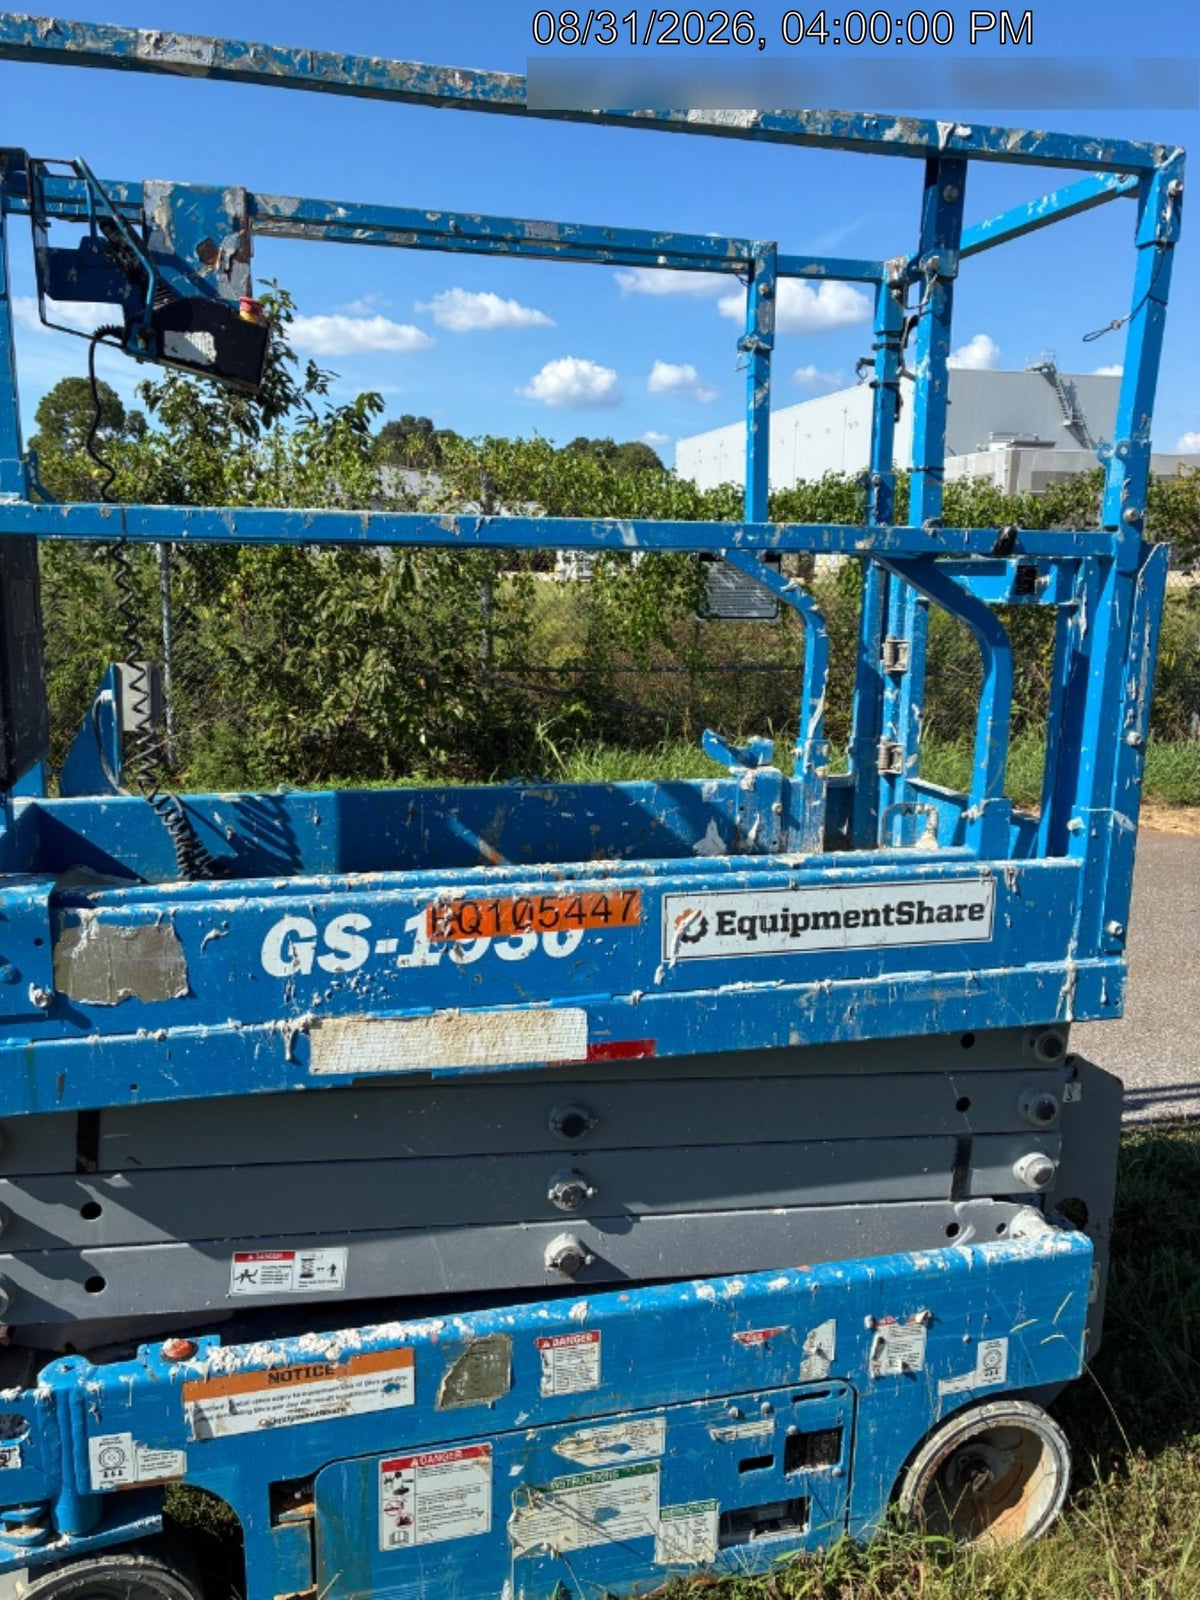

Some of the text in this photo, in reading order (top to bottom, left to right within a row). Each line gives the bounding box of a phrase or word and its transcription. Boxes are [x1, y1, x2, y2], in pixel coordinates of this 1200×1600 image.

[715, 901, 986, 941] EquipmentShare
[553, 1333, 593, 1347] DANGER
[268, 1363, 335, 1384] NOTICE
[420, 1450, 463, 1464] DANGER
[550, 1469, 619, 1490] NSTRUCTIONS
